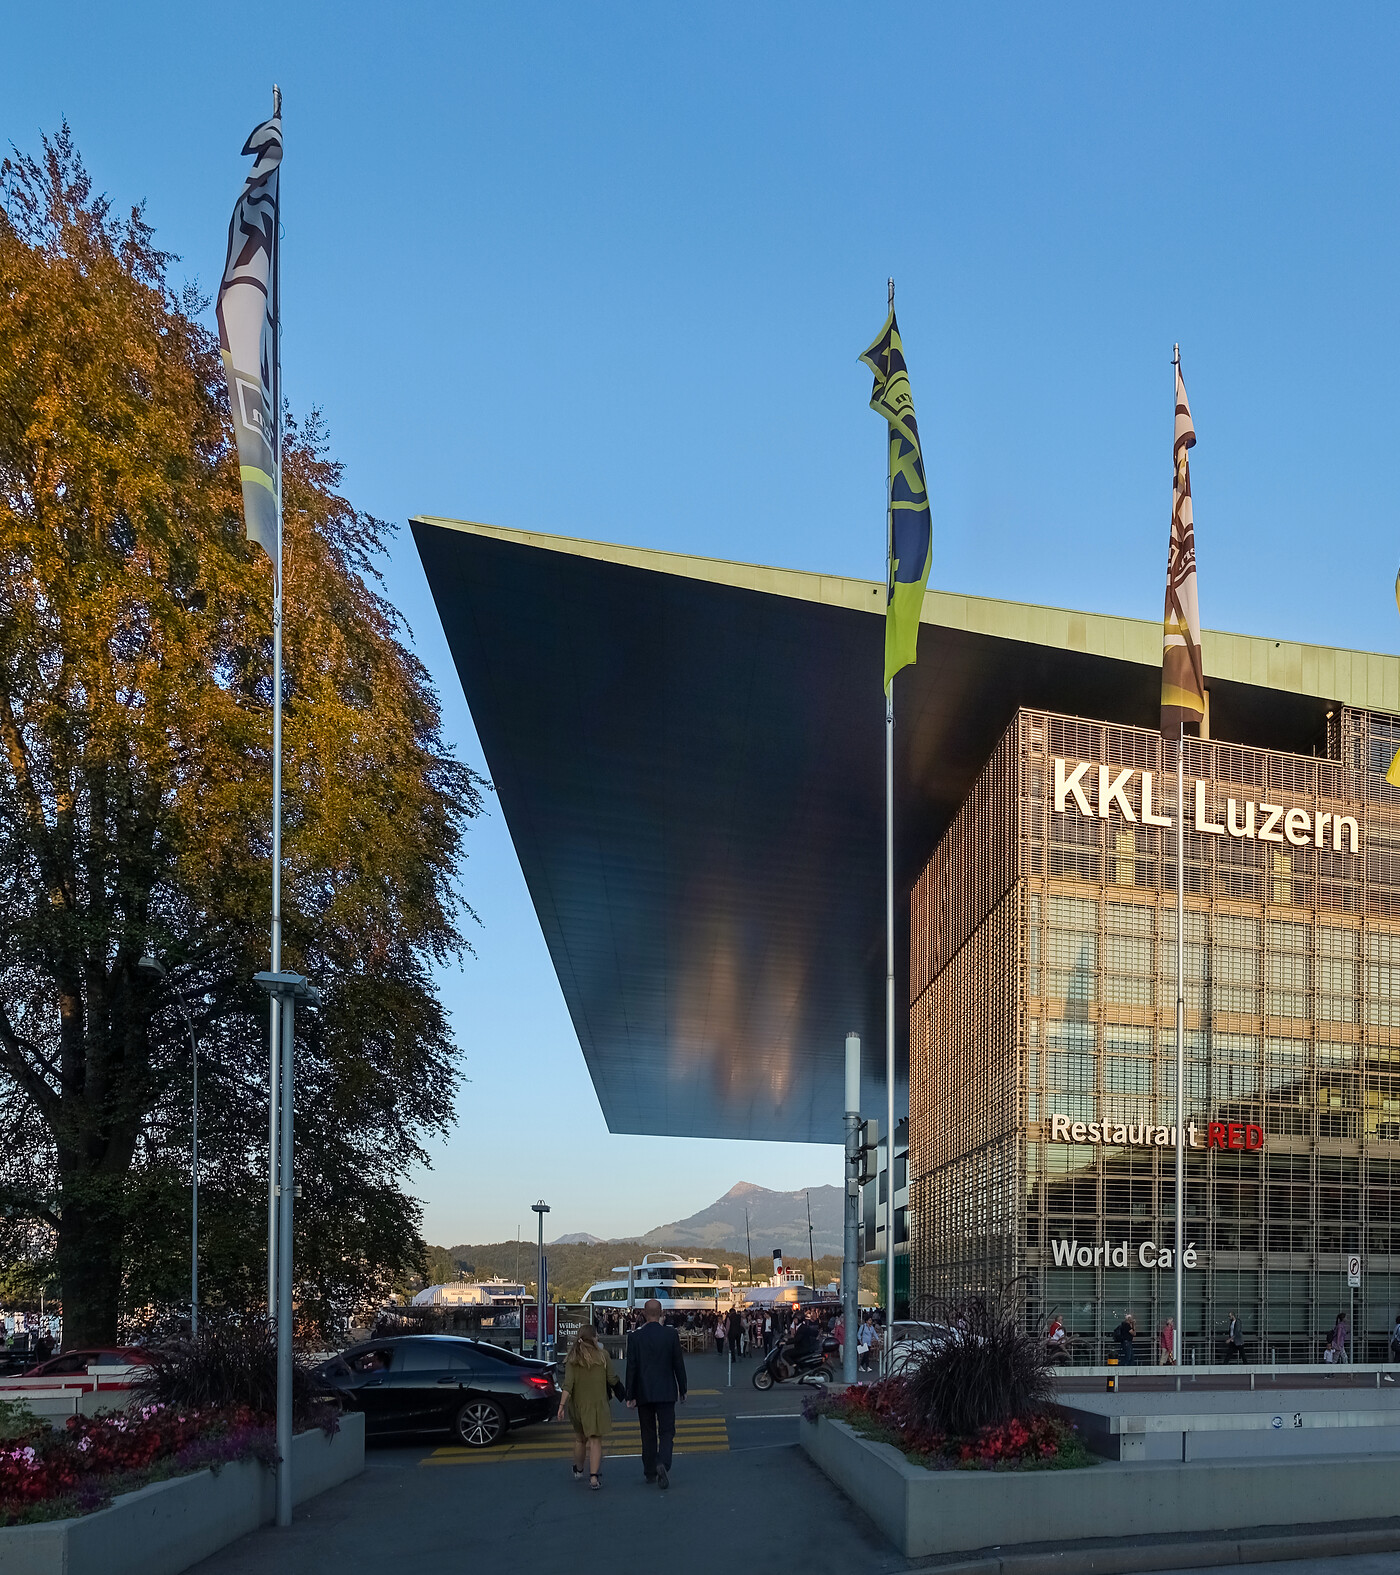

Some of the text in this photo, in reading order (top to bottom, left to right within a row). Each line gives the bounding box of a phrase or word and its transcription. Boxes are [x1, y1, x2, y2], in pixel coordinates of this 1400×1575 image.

[1054, 758, 1359, 853] KKL Luzern
[1208, 1121, 1264, 1150] RED
[1051, 1239, 1198, 1269] World Caé
